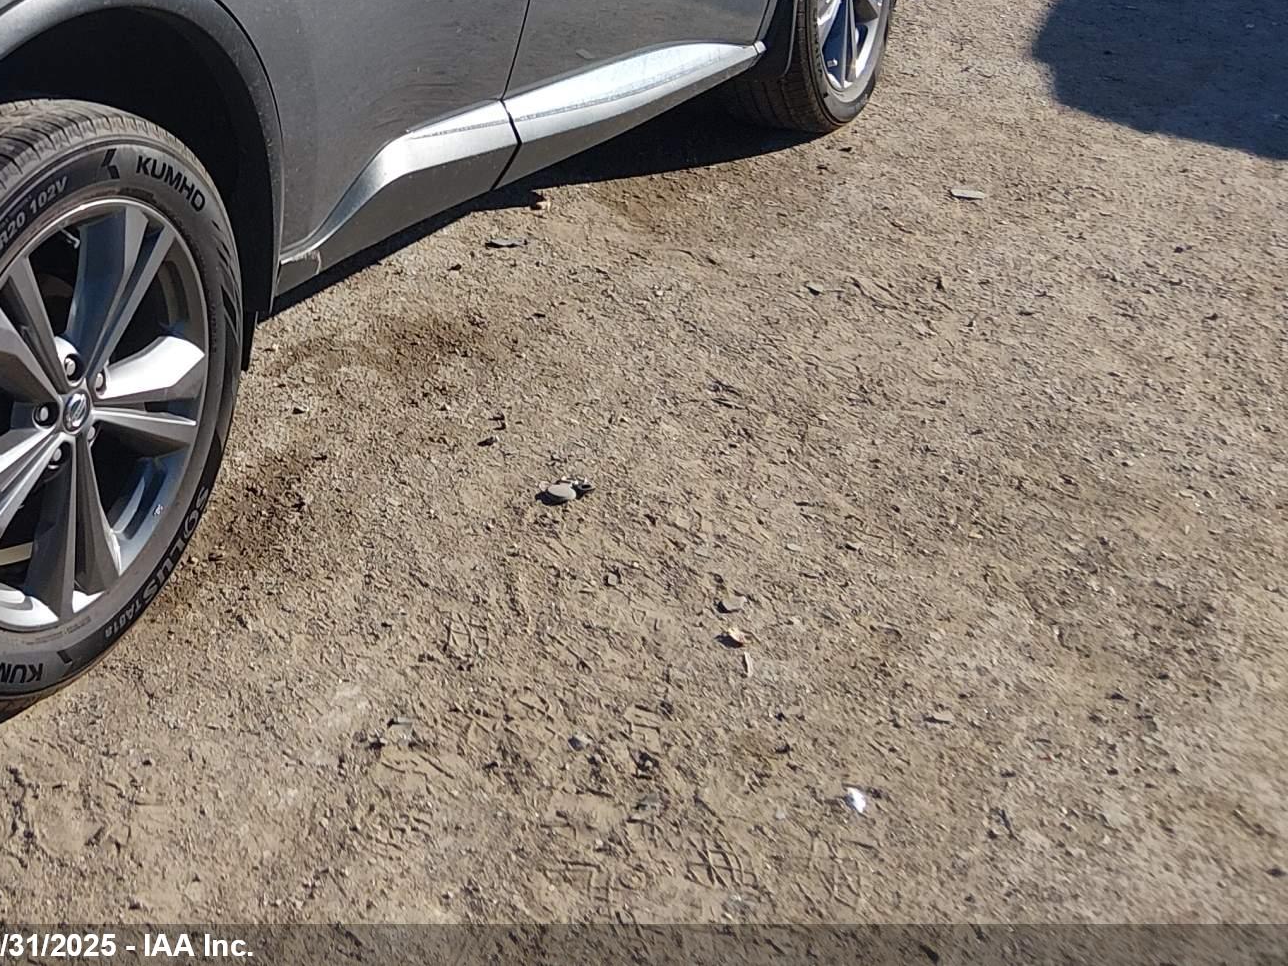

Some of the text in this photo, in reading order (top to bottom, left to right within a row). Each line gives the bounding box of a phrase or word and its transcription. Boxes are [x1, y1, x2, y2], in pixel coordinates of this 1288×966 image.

[29, 175, 70, 216] 102V
[135, 154, 207, 213] KUMHO
[141, 485, 211, 605] SOLUS
